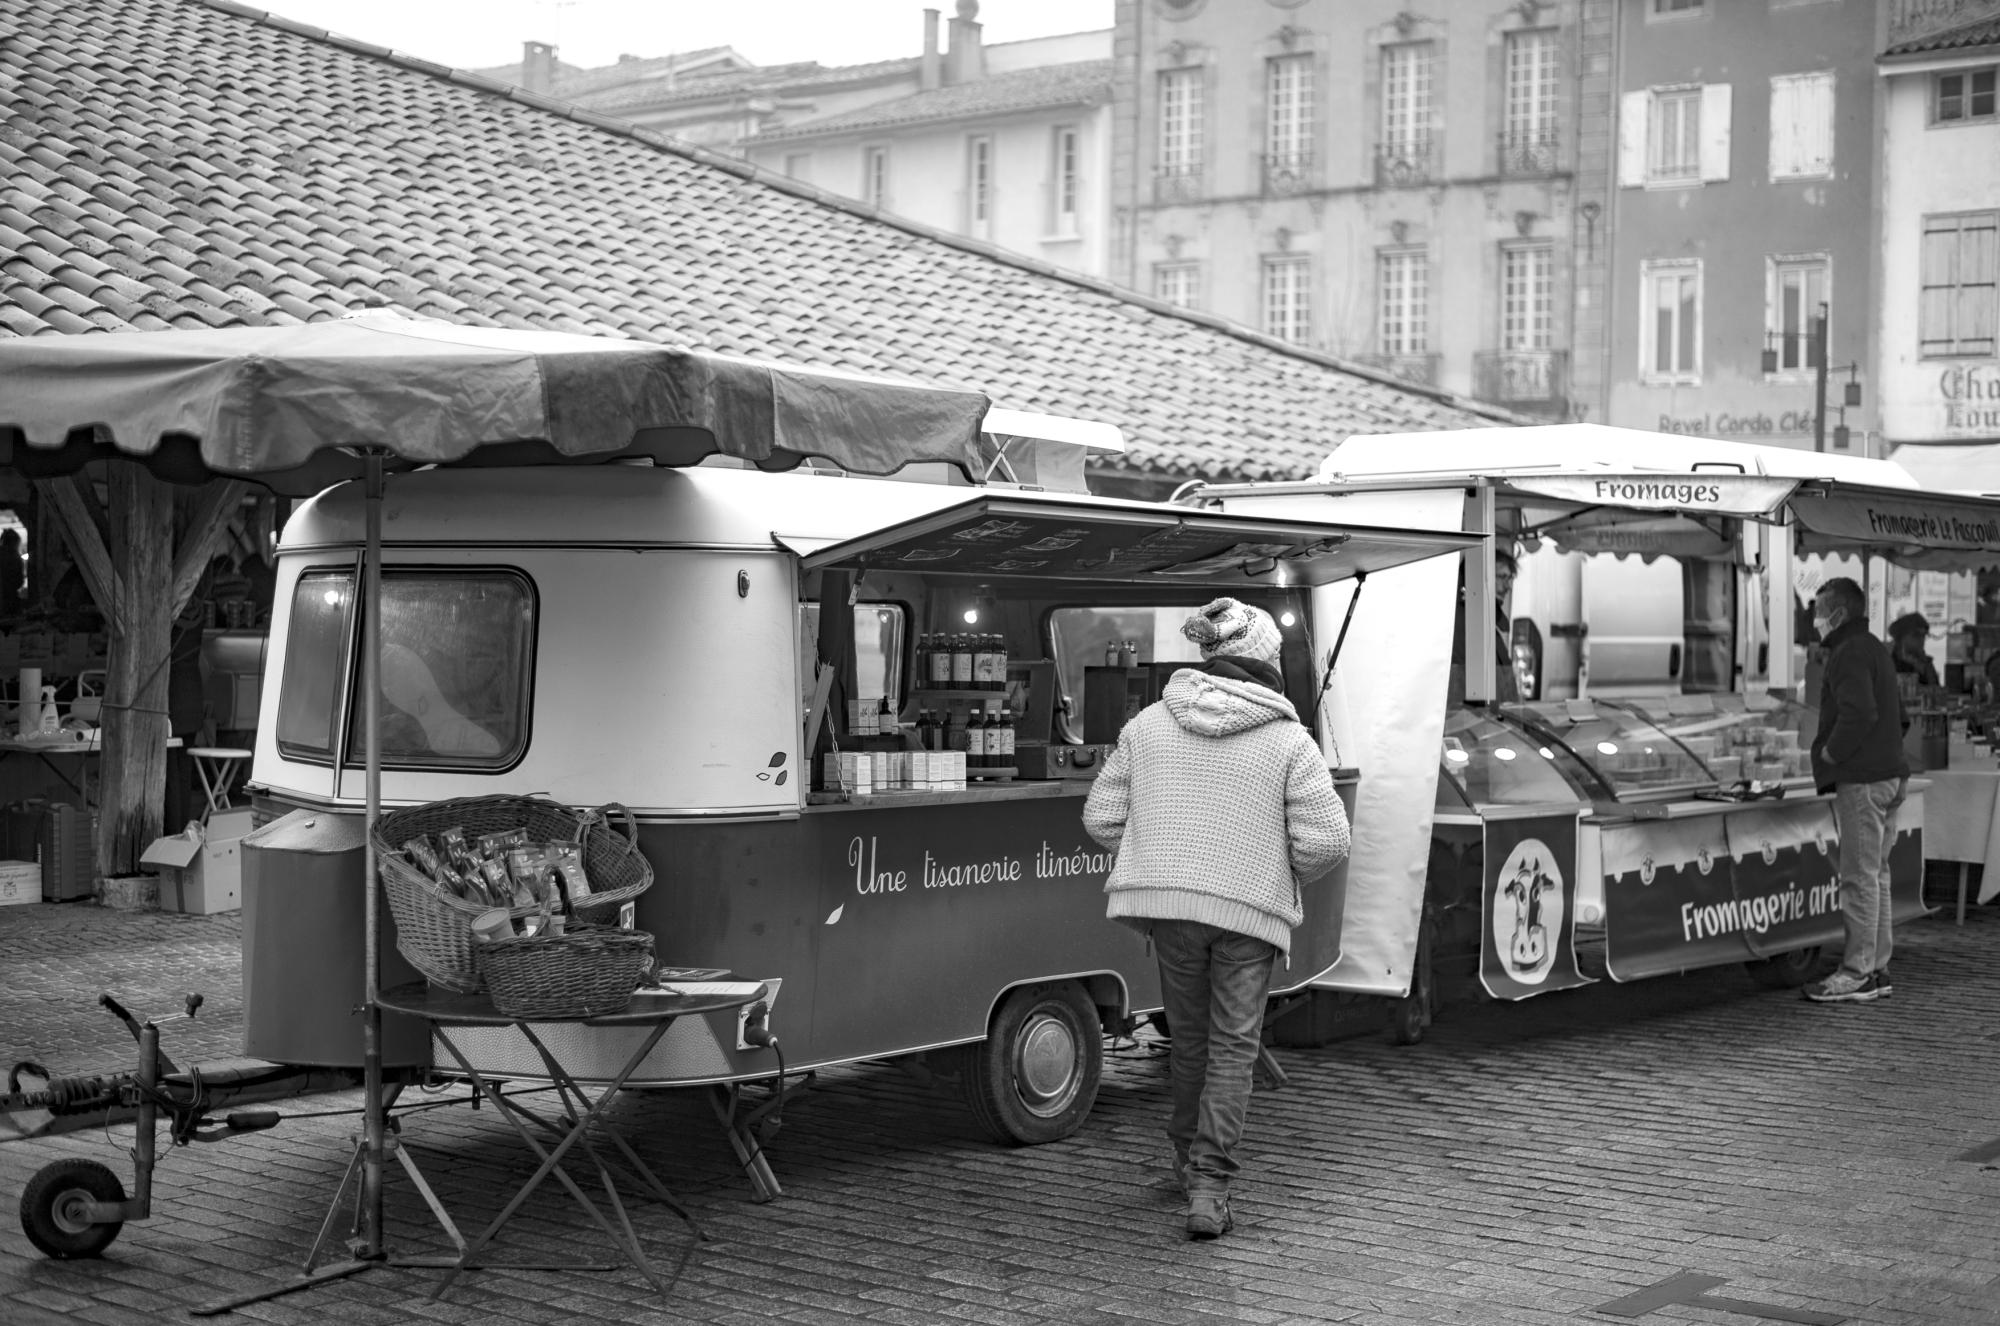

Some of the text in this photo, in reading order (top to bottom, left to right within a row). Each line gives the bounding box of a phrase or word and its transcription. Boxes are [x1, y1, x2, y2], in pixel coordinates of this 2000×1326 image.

[1658, 412, 1710, 433] Revel
[1595, 480, 1720, 504] Fromages
[1867, 508, 1937, 538] Fromagerie
[1935, 515, 1952, 540] Le
[848, 836, 907, 895] Une
[923, 850, 1021, 889] tisanerie
[1681, 881, 1804, 941] Fromagerie
